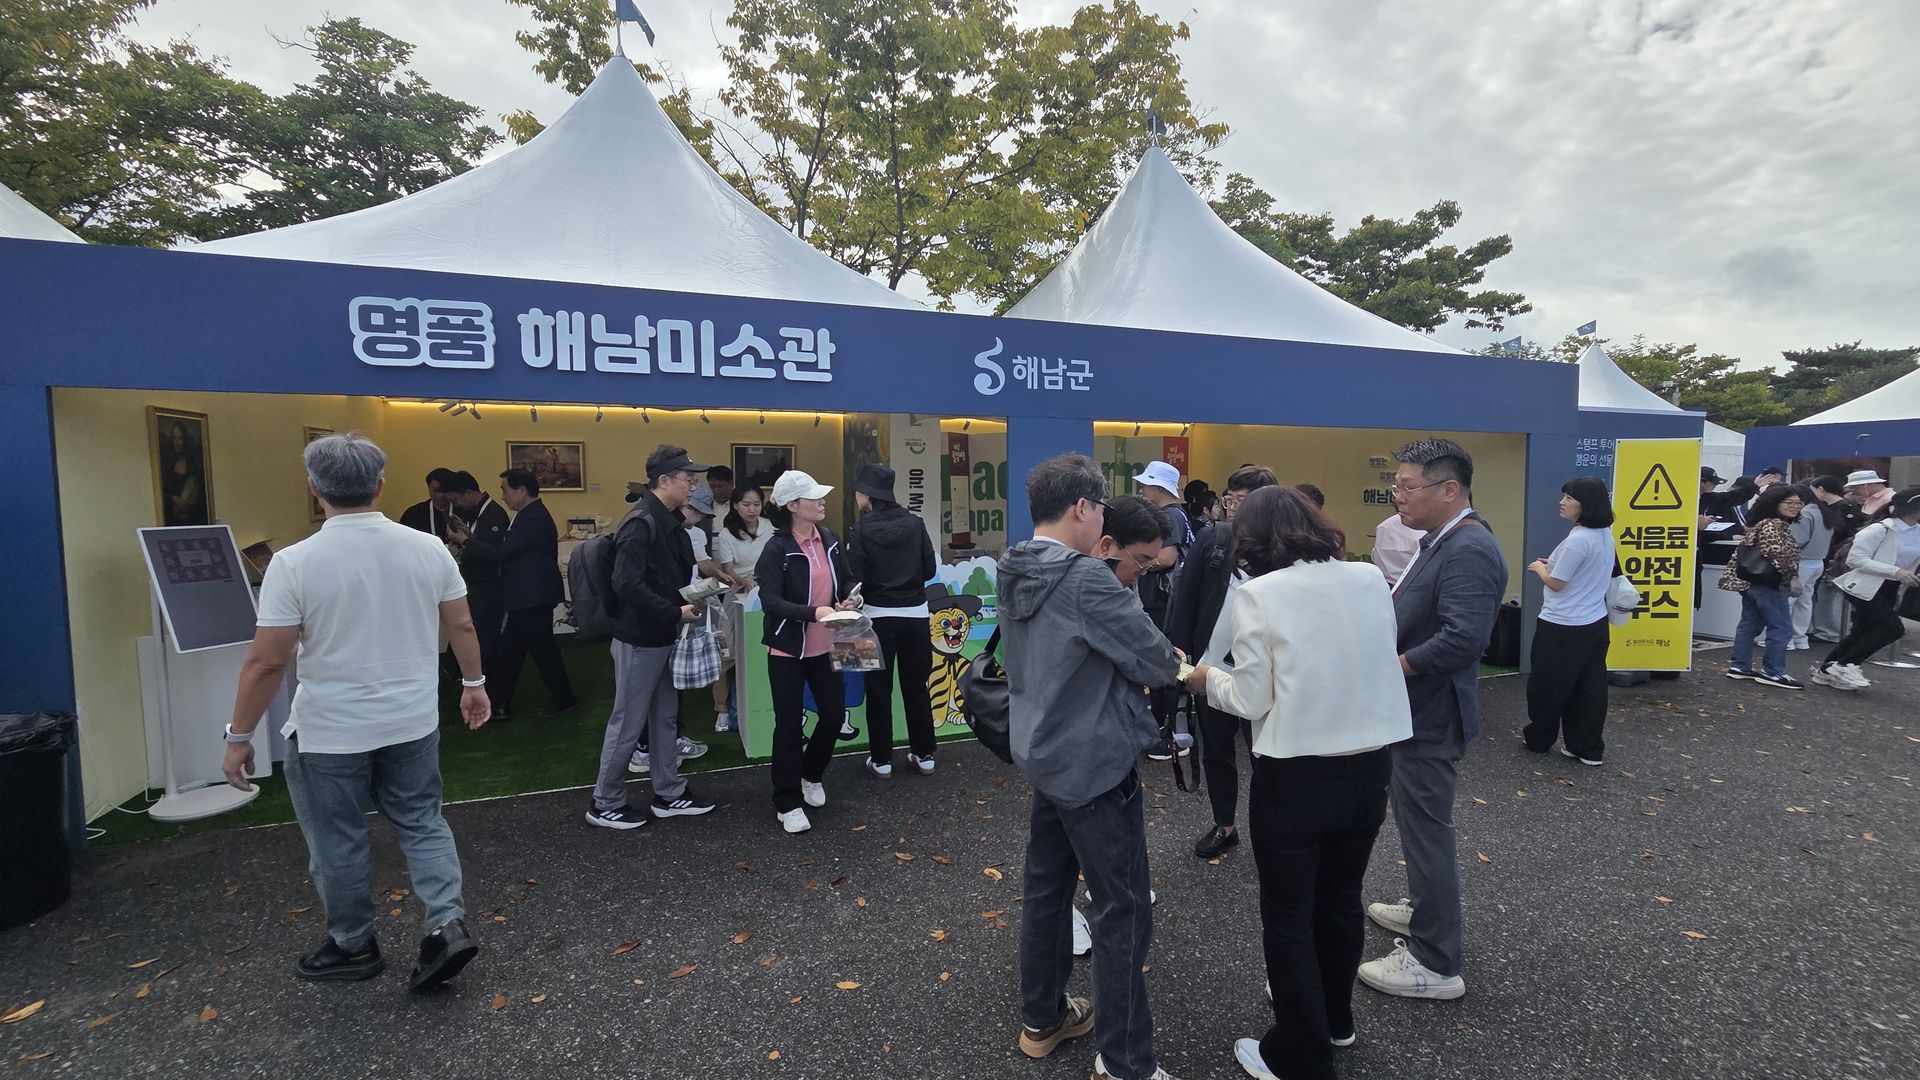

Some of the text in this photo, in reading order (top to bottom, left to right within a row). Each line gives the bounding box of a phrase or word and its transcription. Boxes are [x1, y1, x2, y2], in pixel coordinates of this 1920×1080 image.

[349, 296, 836, 382] 명품 해남미소관
[1012, 355, 1094, 391] 해남군
[907, 468, 924, 513] Oh! My
[1363, 488, 1394, 504] 해남
[1620, 526, 1689, 550] 식음료
[1624, 556, 1682, 586] 안전
[1629, 590, 1680, 620] 부스
